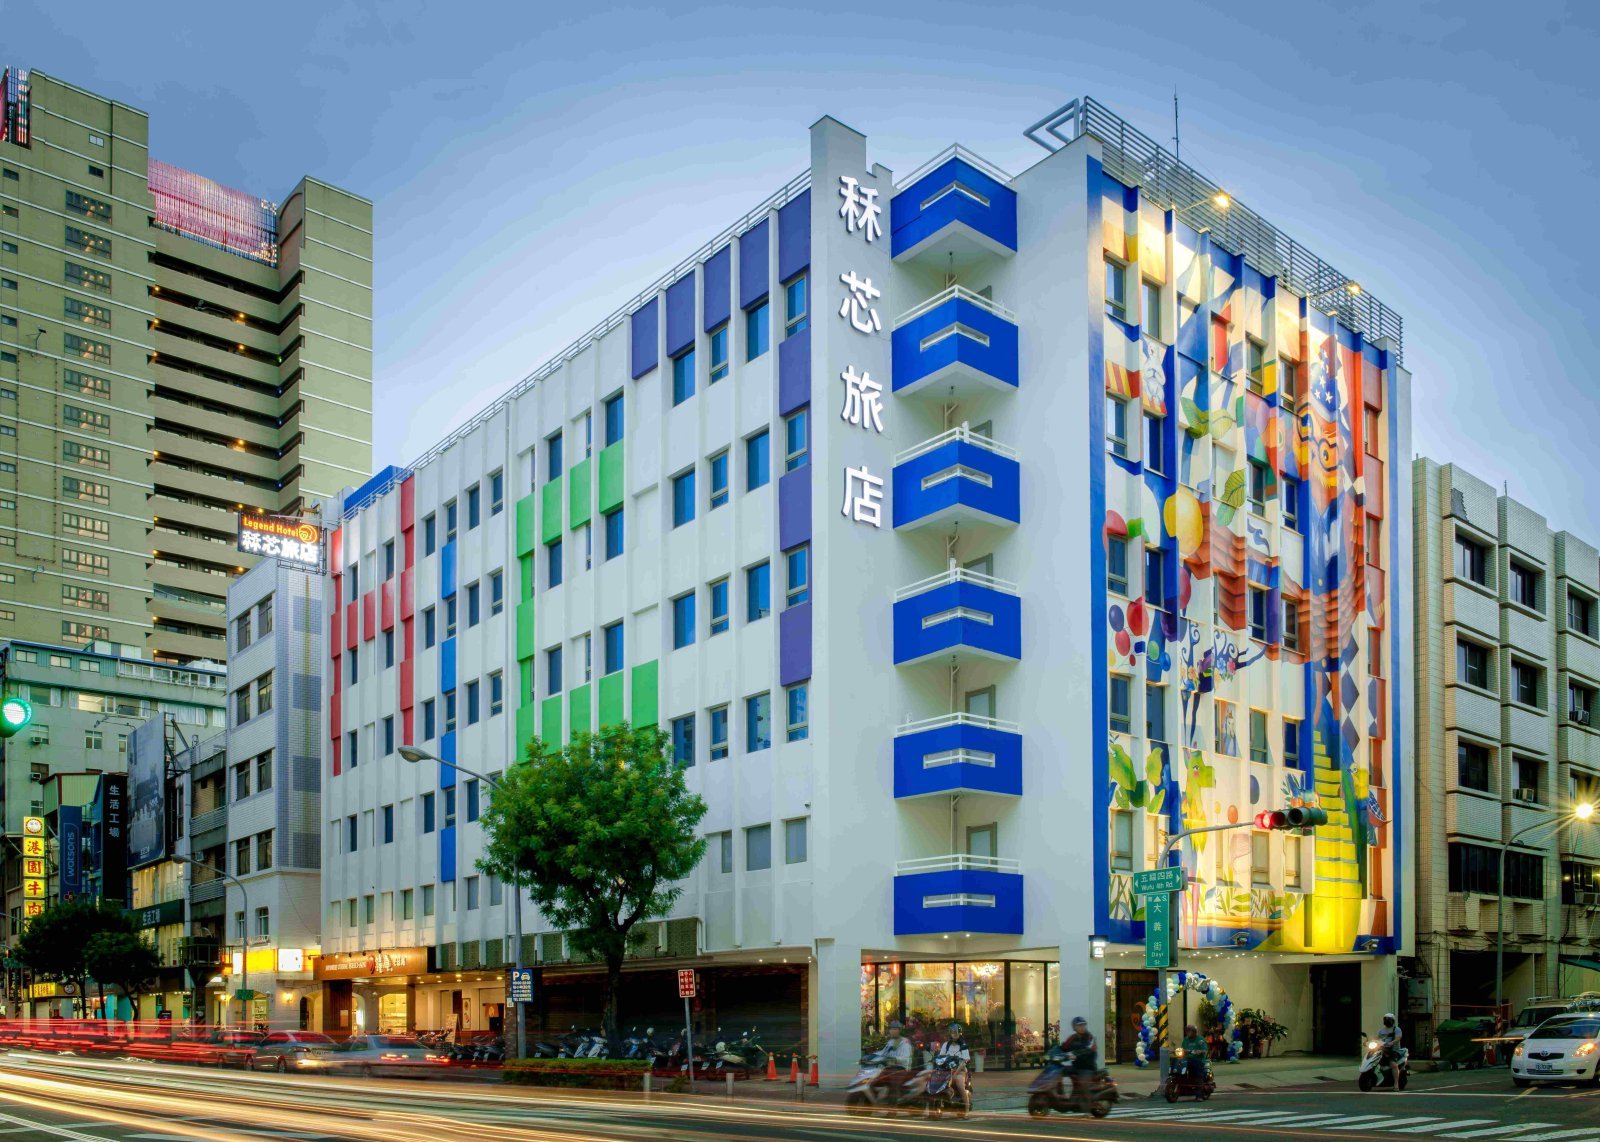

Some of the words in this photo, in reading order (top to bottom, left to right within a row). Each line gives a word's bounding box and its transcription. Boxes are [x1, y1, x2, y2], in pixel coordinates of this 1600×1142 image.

[244, 517, 275, 531] Legend
[276, 524, 299, 536] Hotel
[67, 832, 75, 877] watsons
[1153, 903, 1162, 951] 大義街
[512, 971, 520, 981] P
